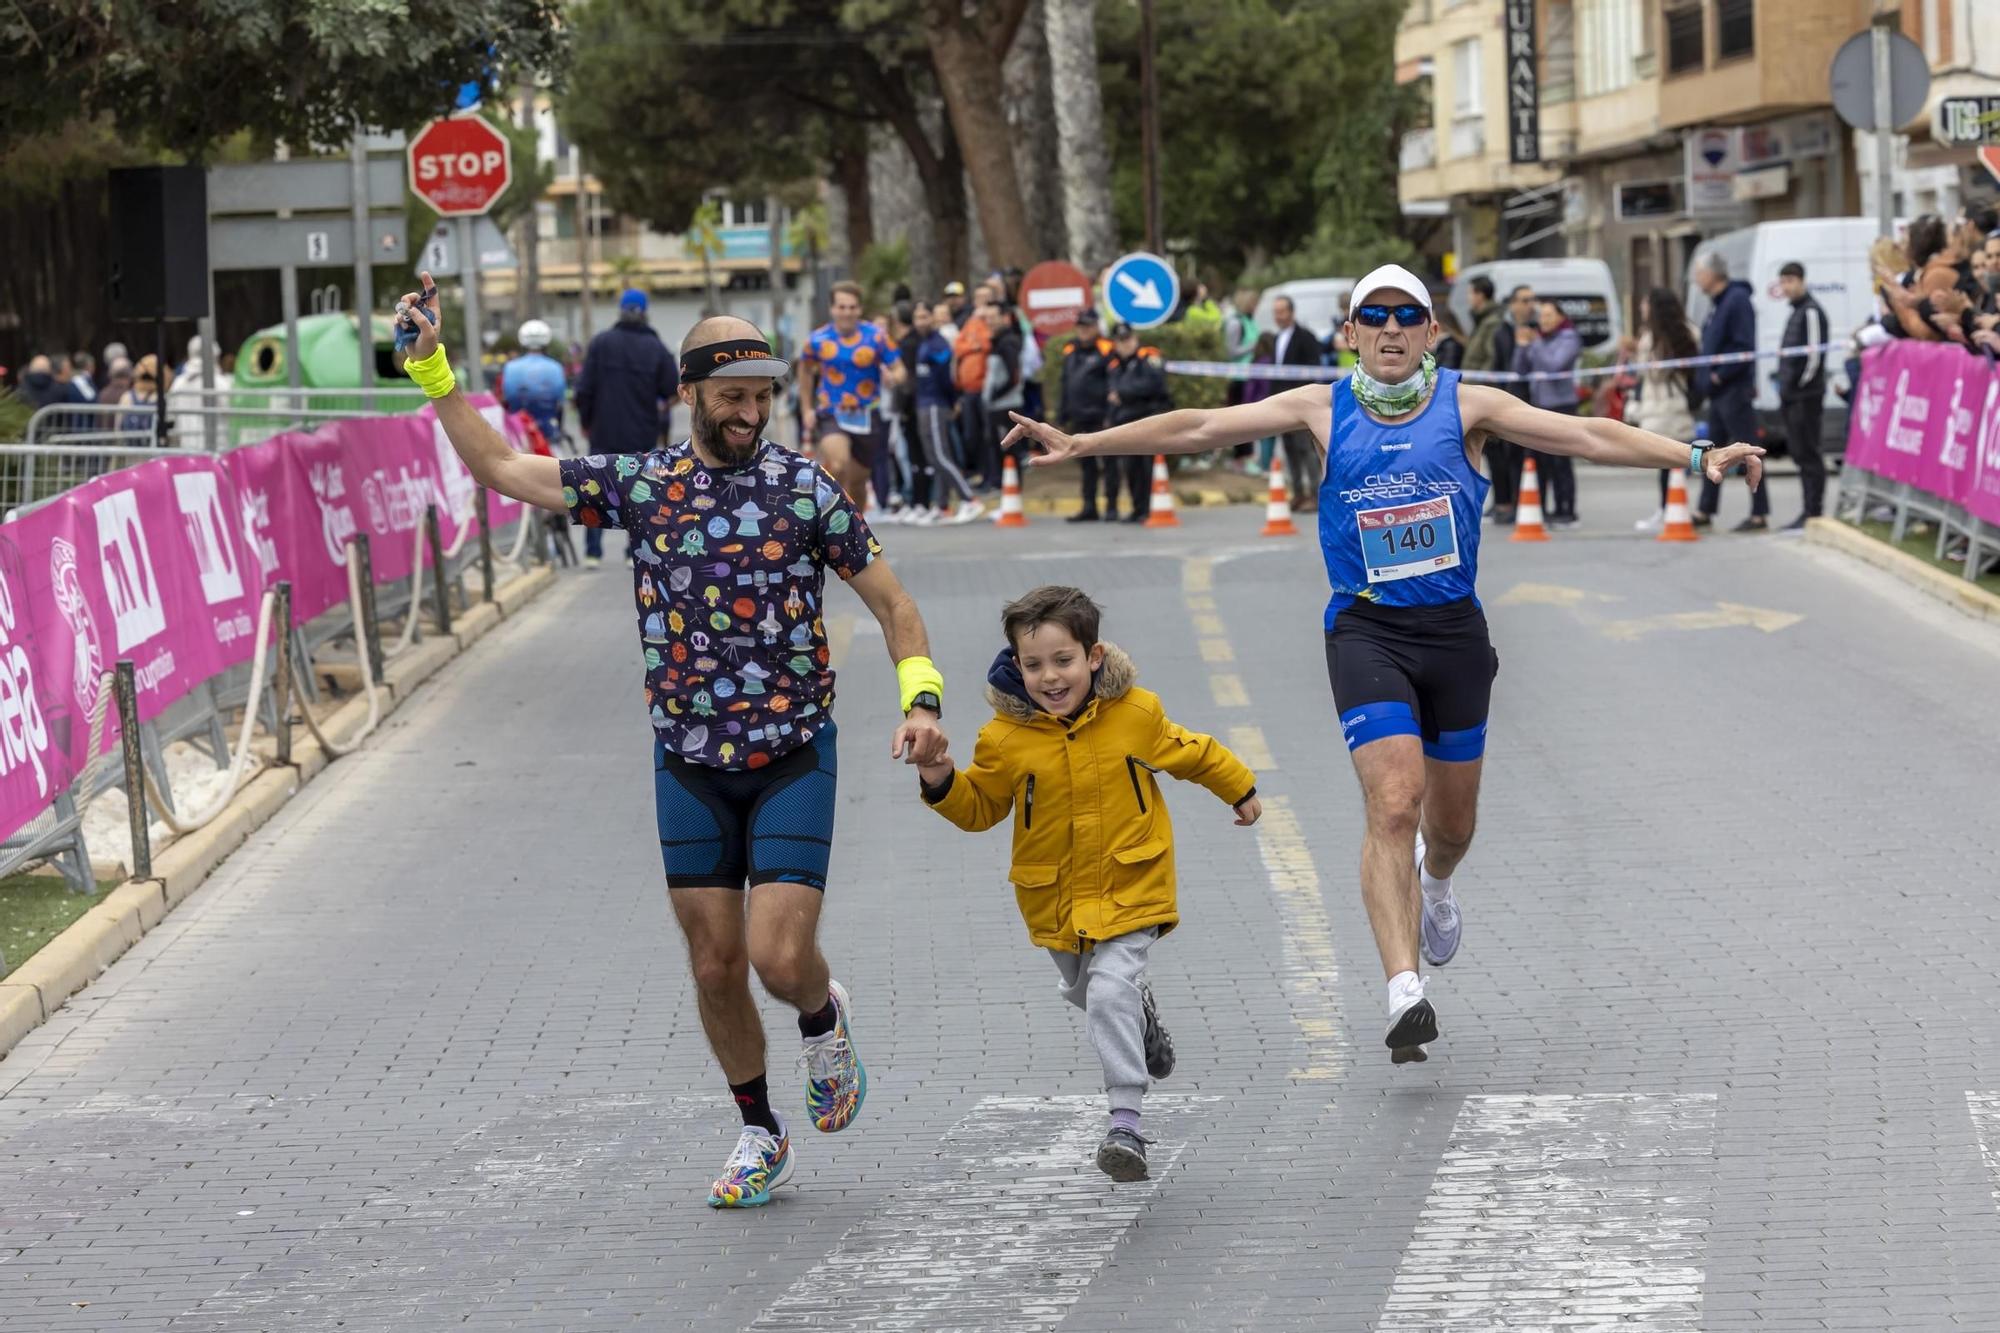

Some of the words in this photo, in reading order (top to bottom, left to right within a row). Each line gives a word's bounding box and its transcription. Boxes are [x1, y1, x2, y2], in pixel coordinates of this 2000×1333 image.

[1509, 0, 1535, 160] URANTE
[418, 151, 502, 180] STOP
[1364, 472, 1417, 487] CLUB
[1382, 523, 1435, 555] 140
